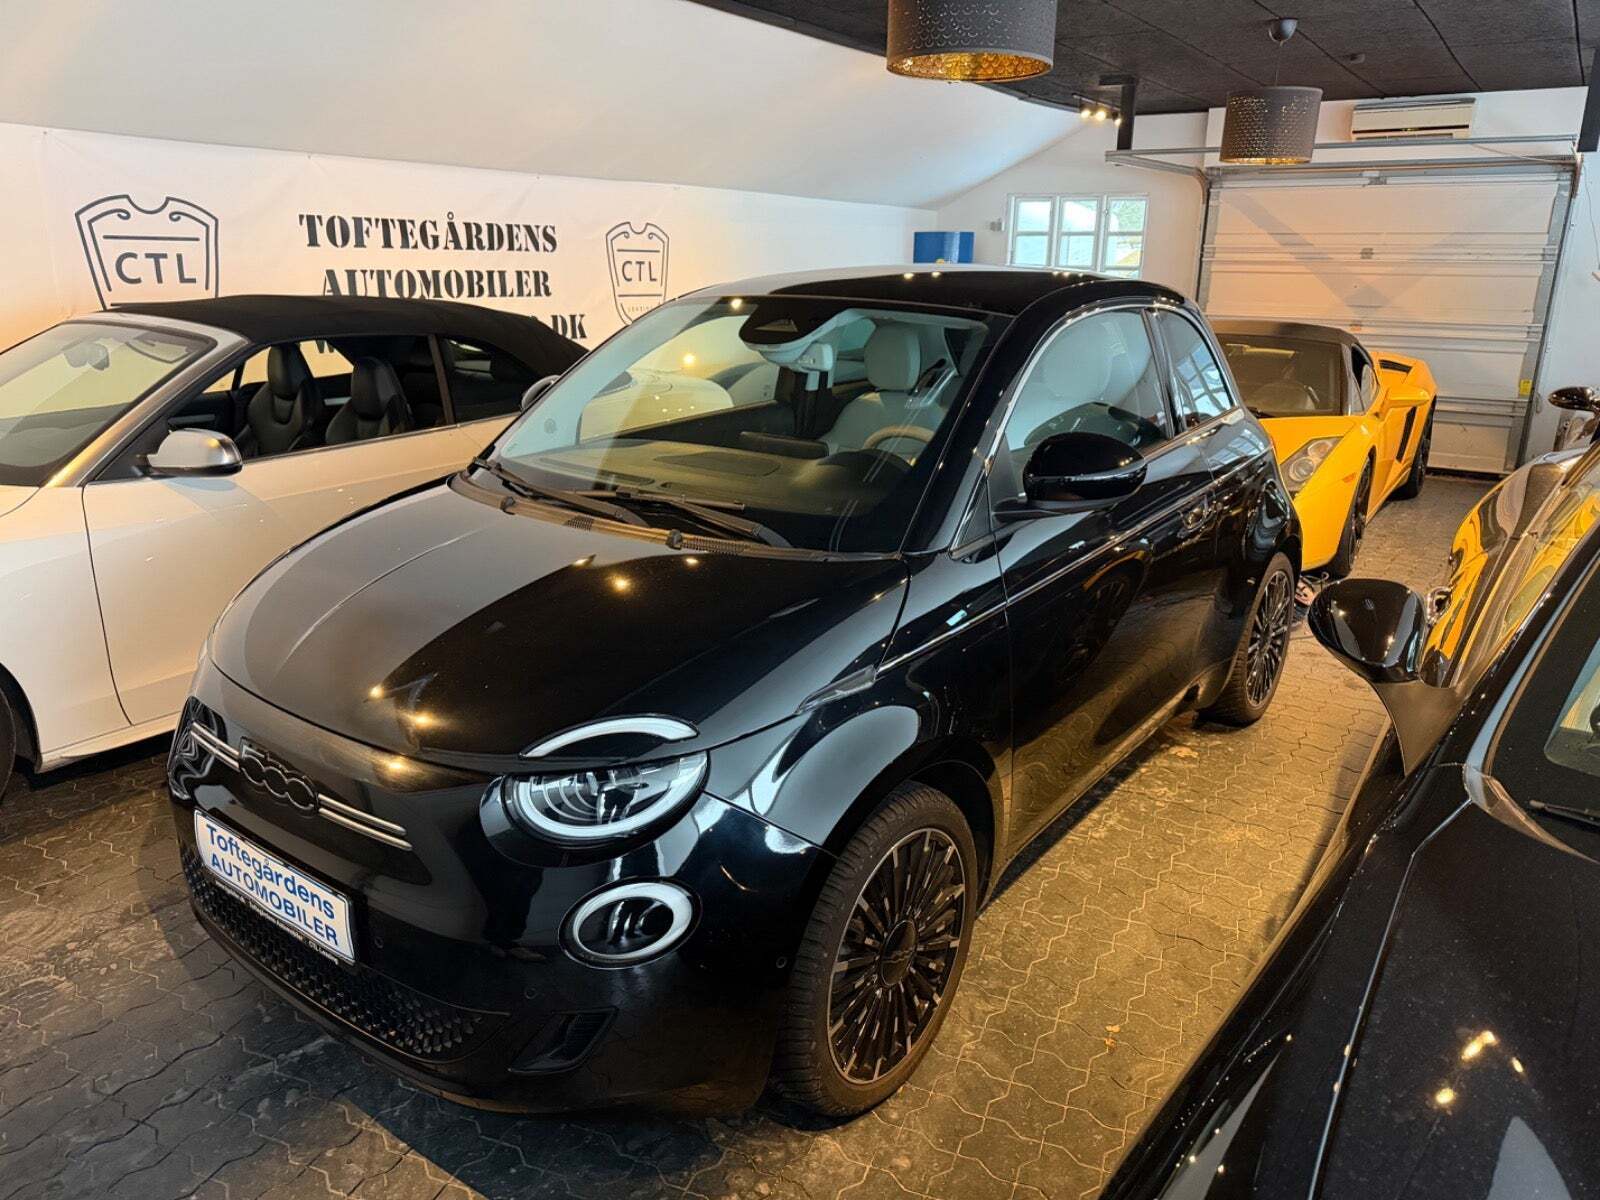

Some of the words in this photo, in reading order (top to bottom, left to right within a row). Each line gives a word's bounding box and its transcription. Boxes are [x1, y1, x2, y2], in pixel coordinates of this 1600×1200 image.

[298, 211, 558, 252] TOFTEGÅRDENS
[115, 252, 197, 284] CTL
[323, 269, 552, 299] AUTOMOBILER
[621, 260, 658, 282] CTL
[206, 824, 335, 920] Toftegårdens
[211, 853, 339, 946] AUTOMOBILER
